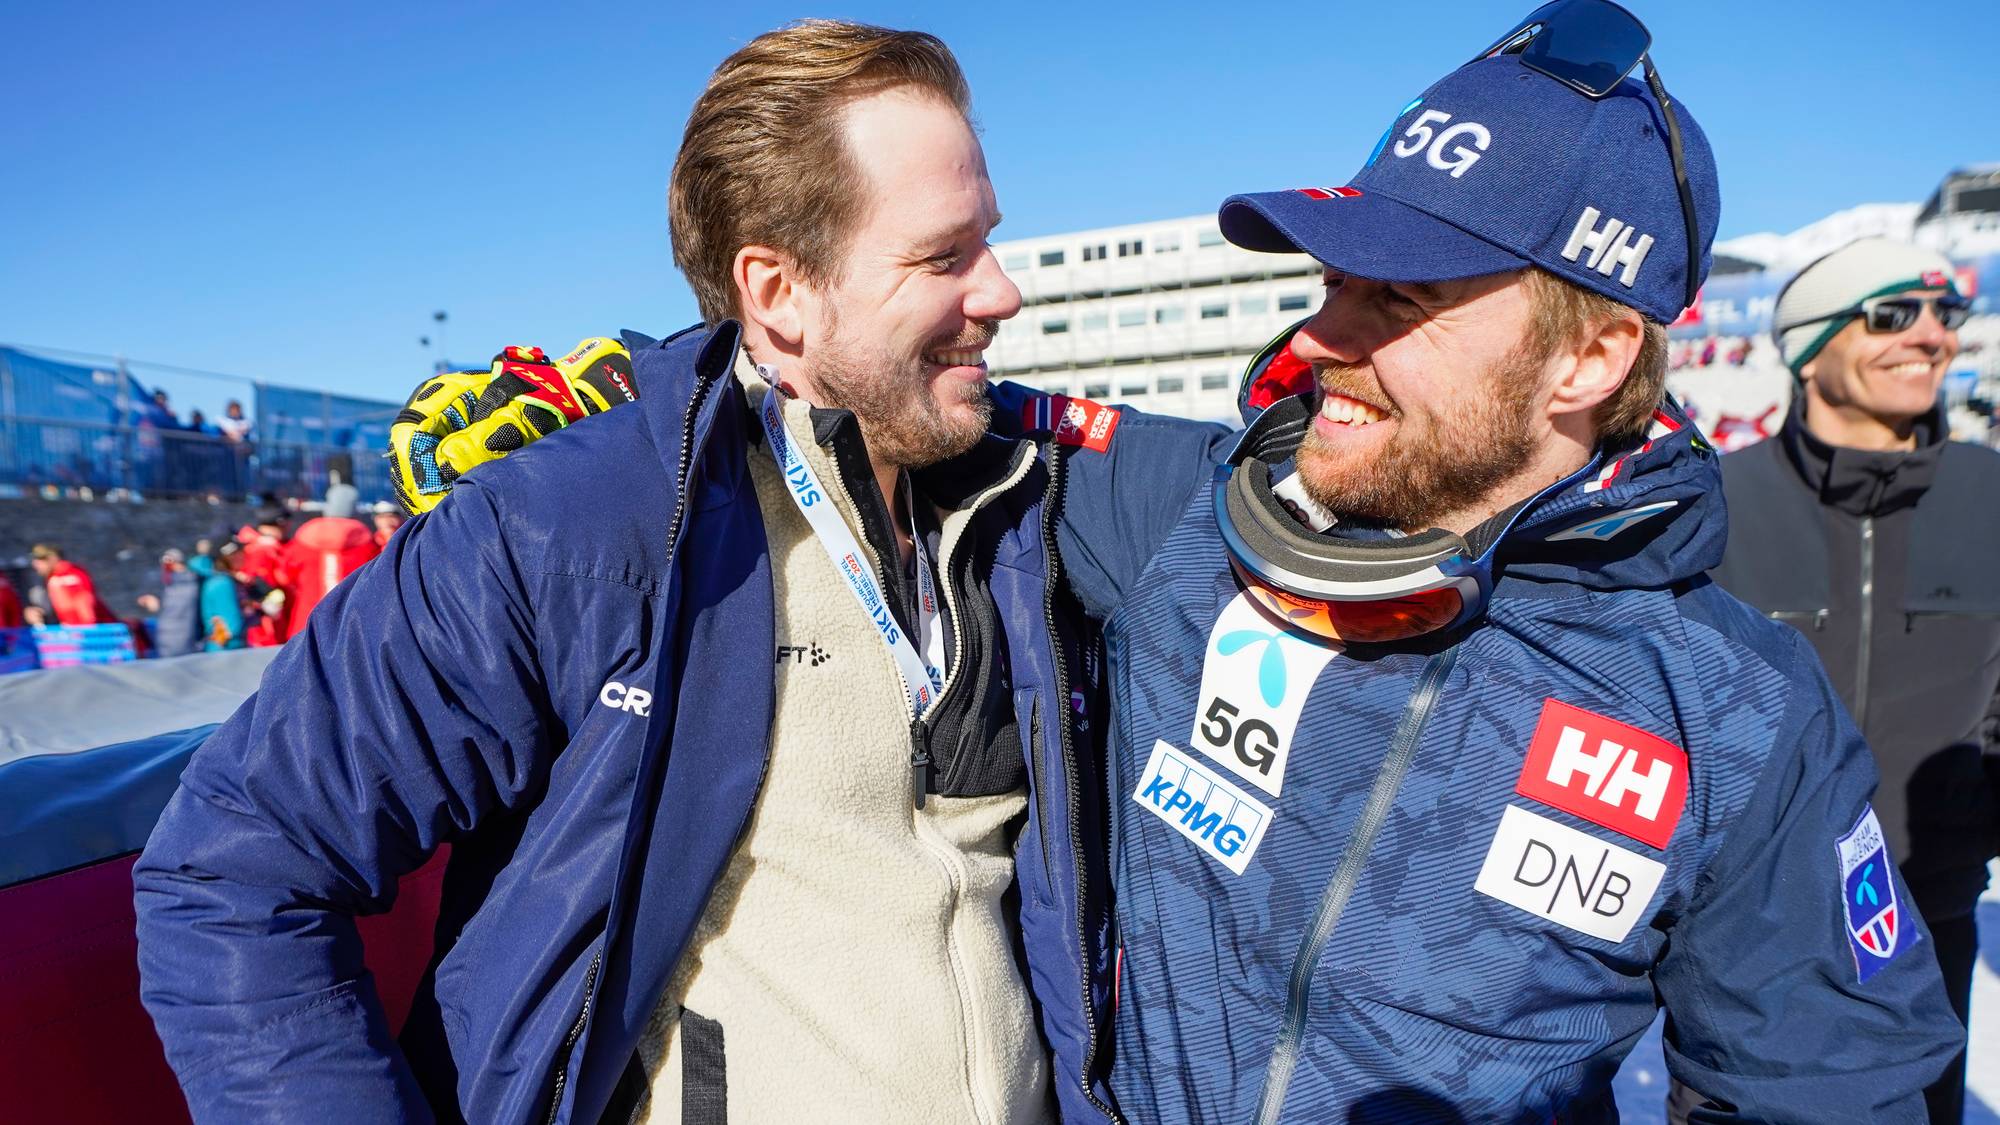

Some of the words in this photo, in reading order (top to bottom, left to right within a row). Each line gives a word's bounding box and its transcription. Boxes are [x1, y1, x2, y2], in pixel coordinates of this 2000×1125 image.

[1393, 109, 1491, 178] 5G
[1561, 206, 1655, 288] HH
[787, 464, 821, 507] SKI
[840, 558, 873, 611] COURCHEVEL
[845, 554, 861, 574] 2023
[859, 573, 878, 607] MERIBEL
[872, 605, 900, 645] SKI
[600, 681, 652, 717] CR
[1200, 696, 1279, 776] 5G
[1546, 726, 1673, 821] HH
[1141, 774, 1247, 858] KPMG
[1513, 838, 1632, 917] DNB
